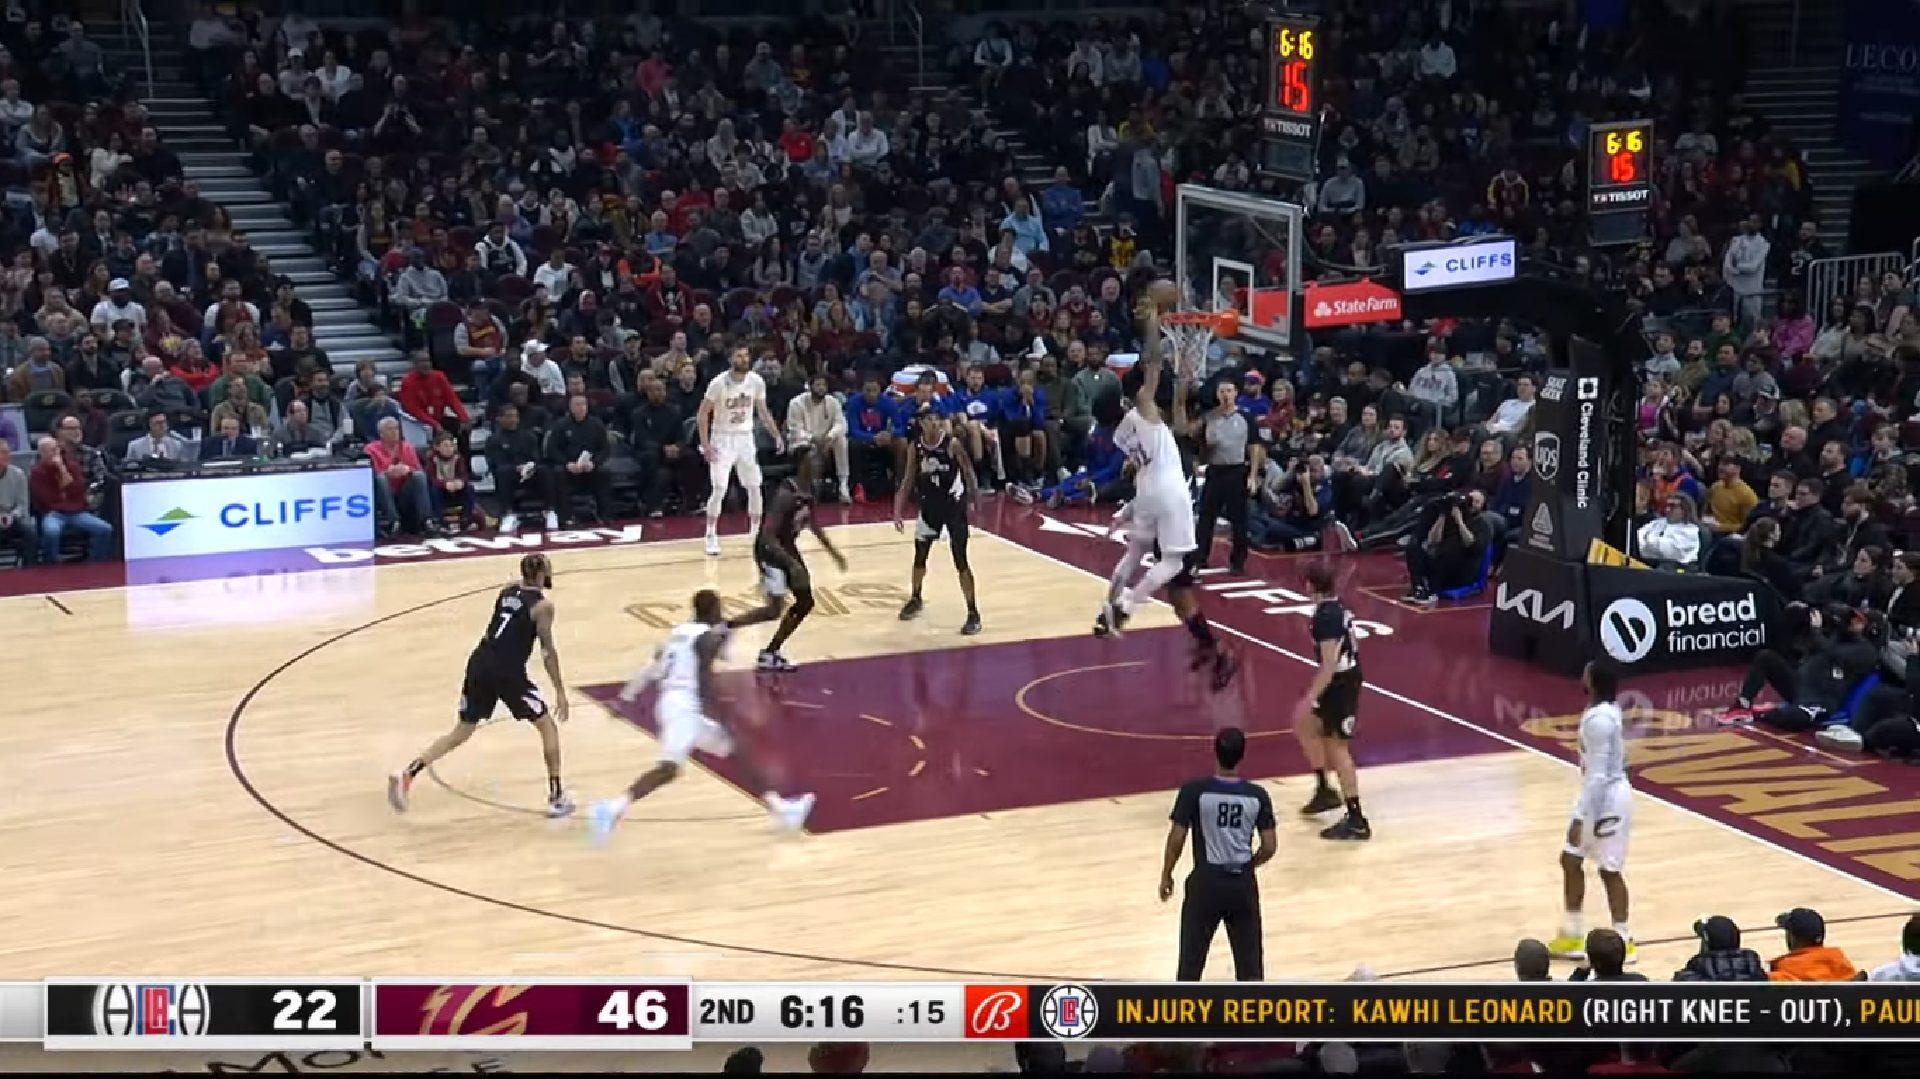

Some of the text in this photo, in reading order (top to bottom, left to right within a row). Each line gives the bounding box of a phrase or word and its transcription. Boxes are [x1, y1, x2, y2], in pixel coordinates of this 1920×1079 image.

[1281, 29, 1313, 60] 6:16
[1284, 62, 1310, 111] 15
[1612, 152, 1635, 181] 15
[1446, 253, 1512, 272] CLIFFS
[1576, 401, 1594, 509] Cleveland Clinic
[220, 495, 371, 528] CLIFFS
[303, 524, 643, 563] betway
[494, 612, 513, 639] 7
[1666, 593, 1757, 627] bread
[1667, 623, 1765, 652] financial
[1217, 802, 1243, 828] 82
